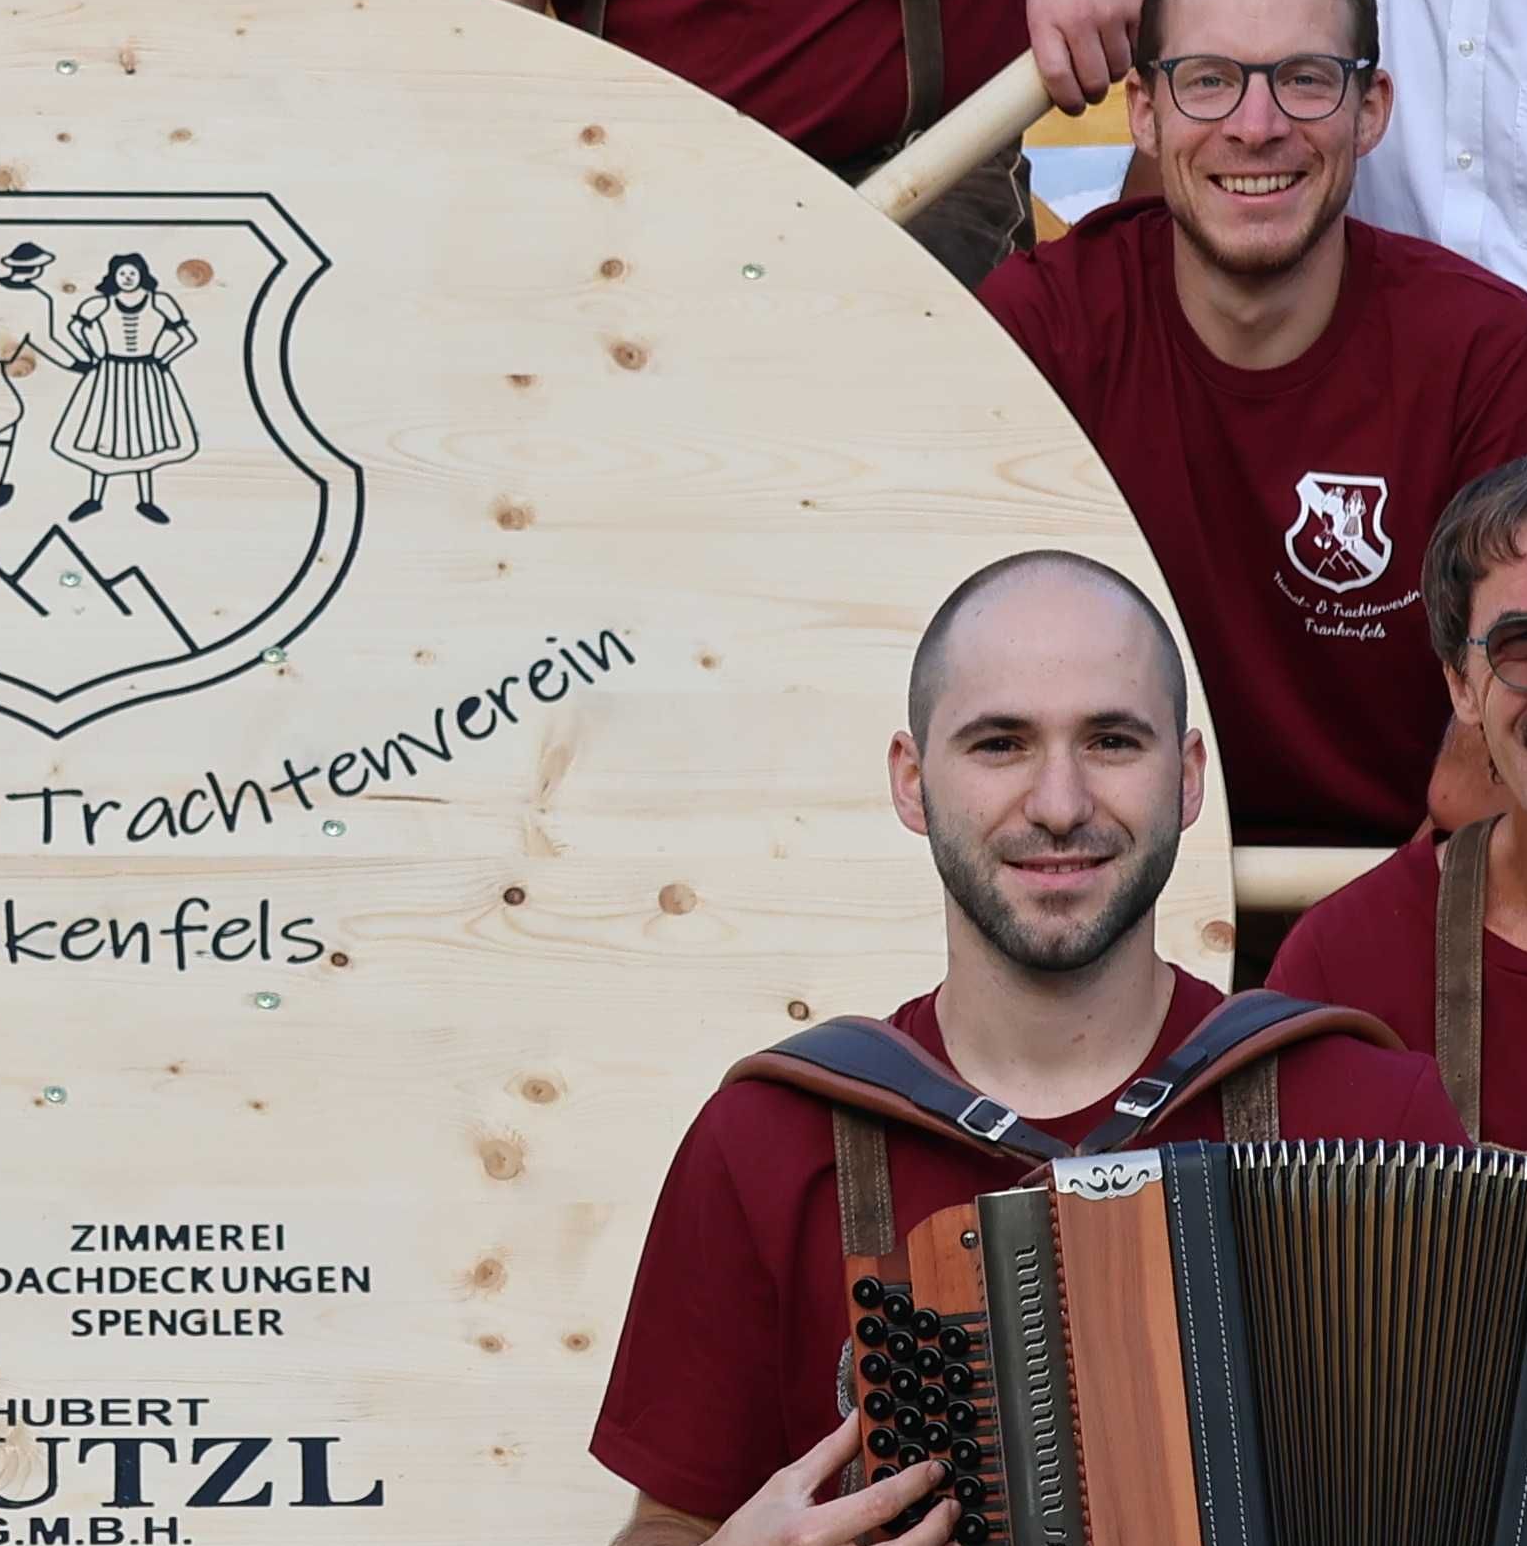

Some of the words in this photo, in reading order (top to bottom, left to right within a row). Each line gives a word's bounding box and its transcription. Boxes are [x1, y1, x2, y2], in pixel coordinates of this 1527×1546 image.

[1315, 598, 1329, 615] &
[1333, 588, 1422, 619] Trachtenverein
[1305, 616, 1387, 642] Frankenfels
[5, 629, 636, 846] Trachtenverein
[71, 1224, 285, 1252] ZIMMEREI
[71, 1308, 284, 1337] SPENGLER
